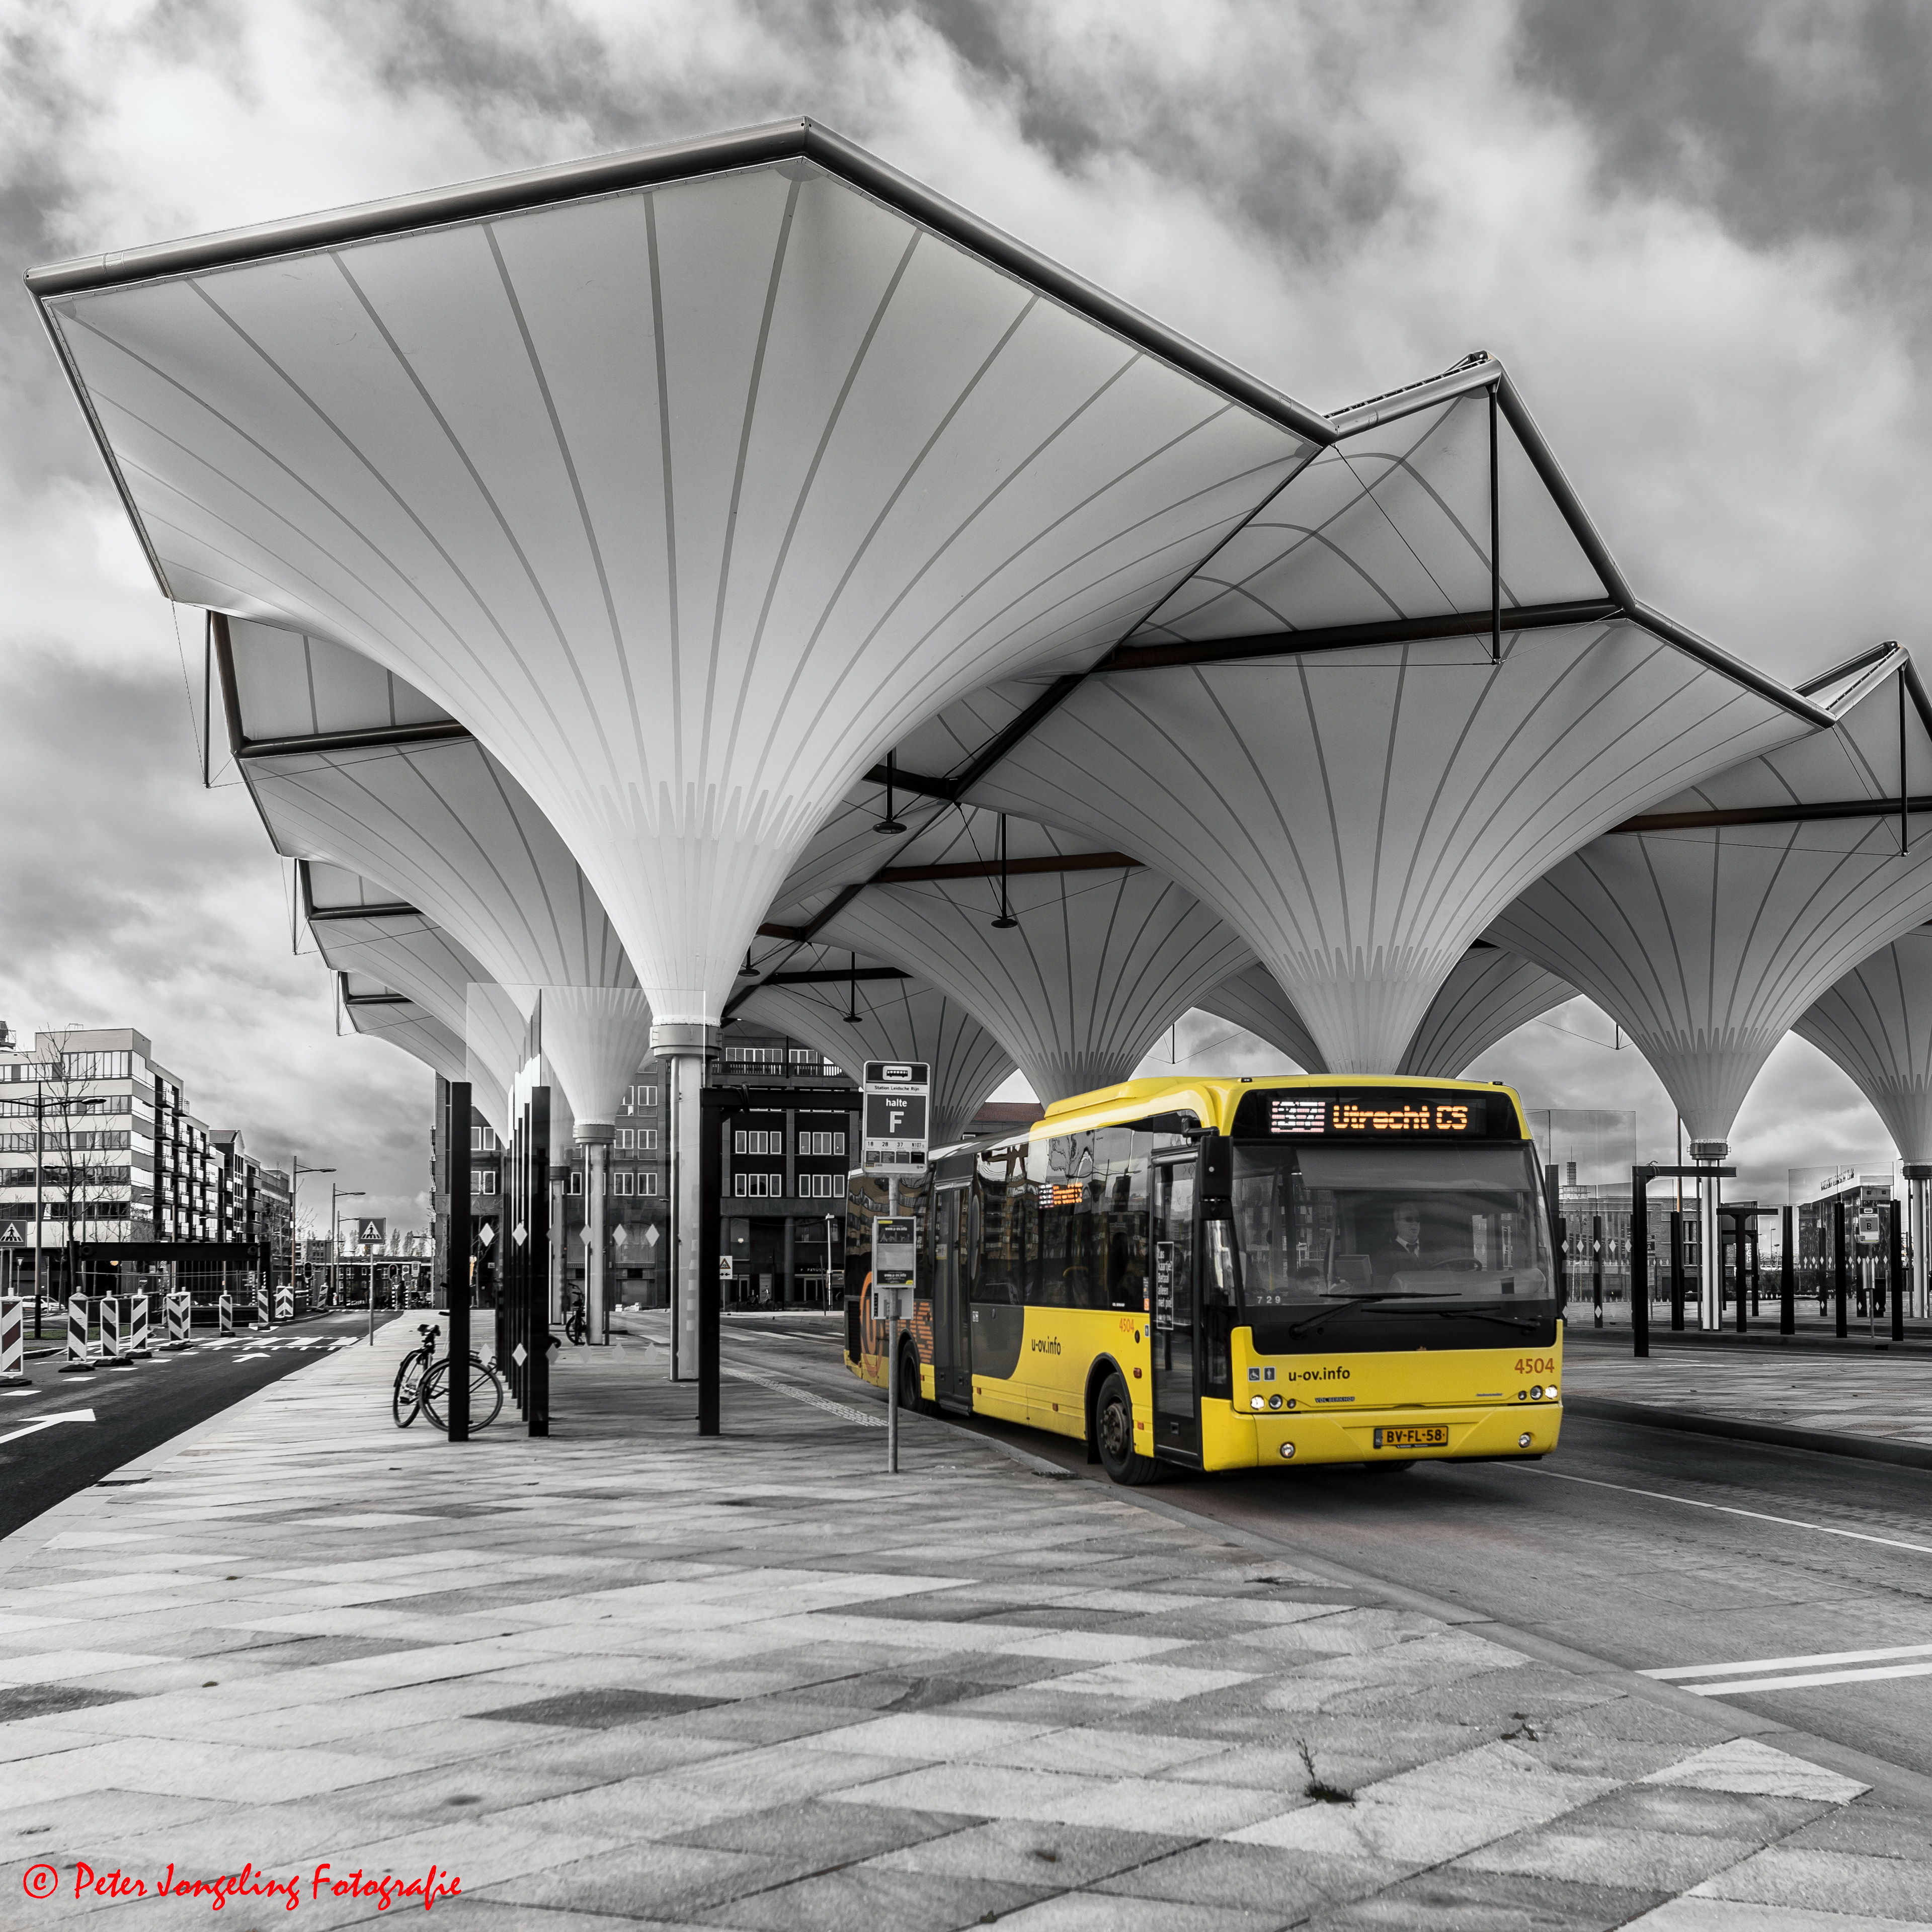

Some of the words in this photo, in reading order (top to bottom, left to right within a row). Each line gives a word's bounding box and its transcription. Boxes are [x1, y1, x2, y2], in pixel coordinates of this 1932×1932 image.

[886, 1098, 908, 1107] halte
[890, 1111, 904, 1133] F
[1333, 1105, 1430, 1130] Utrecht
[1436, 1105, 1468, 1130] CS
[1119, 1318, 1135, 1333] 4504
[1031, 1336, 1061, 1355] u-ov.info
[1289, 1366, 1350, 1382] u-ov.info
[1514, 1358, 1555, 1374] 4504
[1387, 1429, 1442, 1443] BV-FL-58
